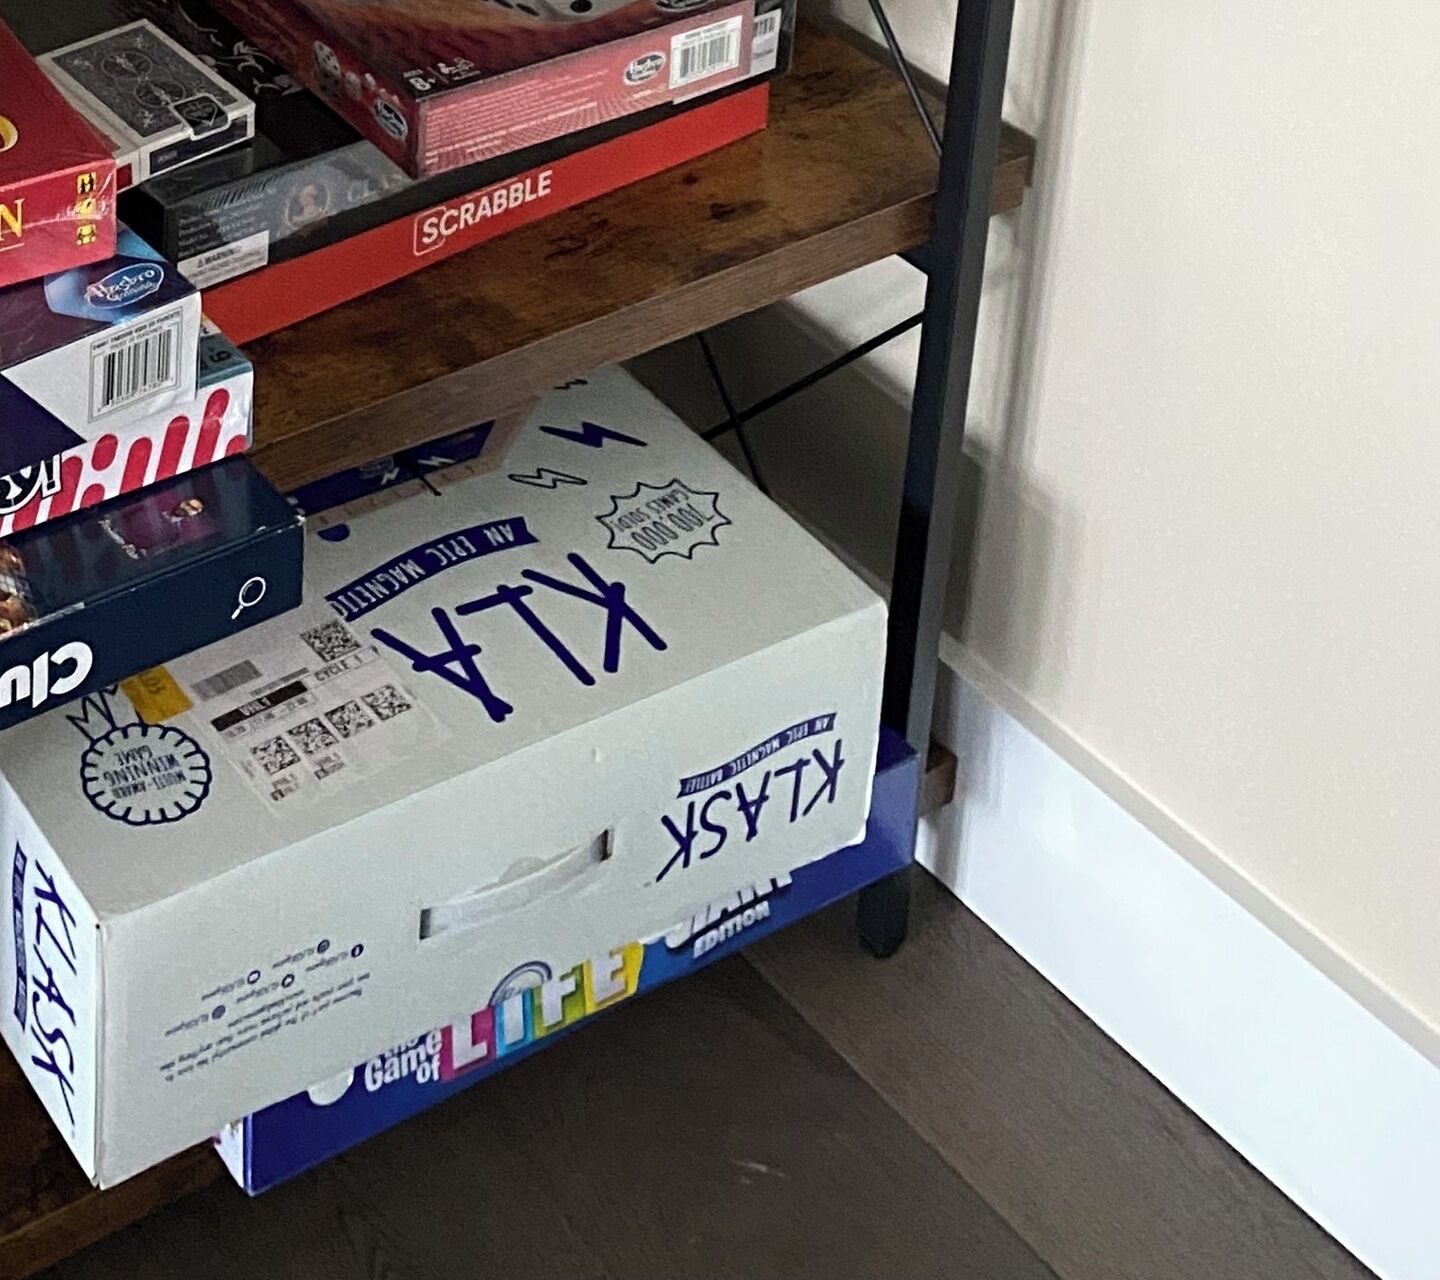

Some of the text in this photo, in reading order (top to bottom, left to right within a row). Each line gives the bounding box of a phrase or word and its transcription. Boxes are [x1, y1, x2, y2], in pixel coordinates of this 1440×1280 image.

[421, 170, 553, 245] SCRABBLE
[84, 269, 156, 298] Hasbro
[437, 527, 479, 565] EPIC
[486, 521, 516, 547] AN
[102, 753, 179, 784] WINNING
[115, 744, 154, 765] GAME
[112, 771, 187, 800] MULTI-AWARD
[657, 737, 847, 884] KLASK
[693, 900, 772, 959] EDITION
[30, 858, 78, 1128] KLASK
[449, 946, 632, 1072] LIFE
[363, 1027, 442, 1094] Game
[415, 1060, 442, 1086] of
